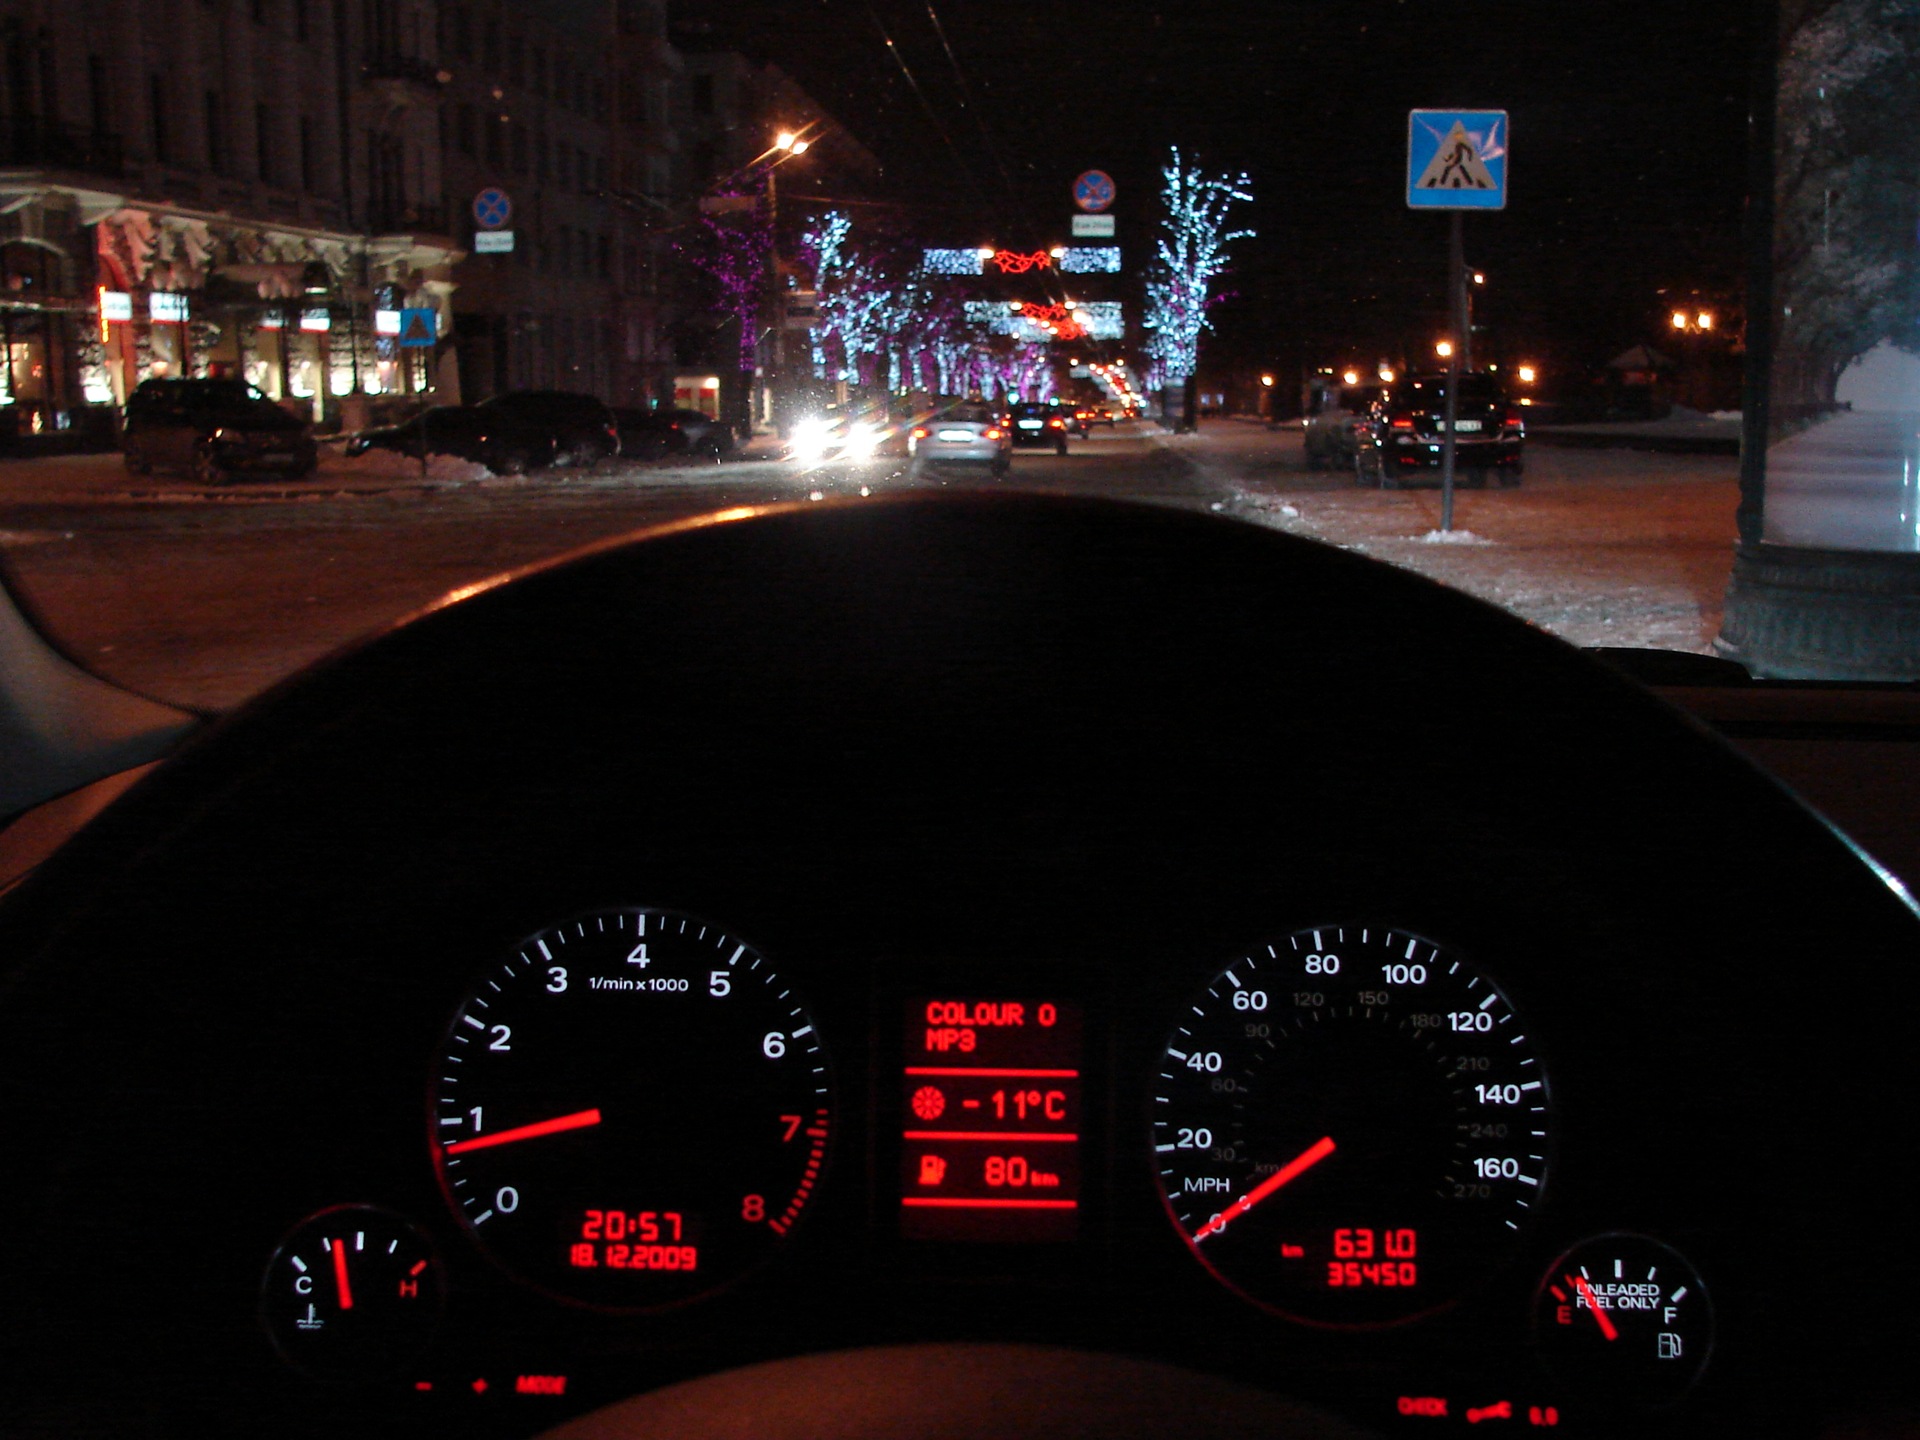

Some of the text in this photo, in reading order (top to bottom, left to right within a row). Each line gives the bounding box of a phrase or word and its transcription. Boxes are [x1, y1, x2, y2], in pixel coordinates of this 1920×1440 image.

[627, 944, 650, 968] 4
[1305, 955, 1340, 975] 80
[546, 966, 568, 993] 3
[709, 971, 731, 997] 5
[1381, 964, 1427, 985] 100
[1232, 990, 1268, 1011] 60
[1292, 992, 1324, 1007] 120
[1358, 991, 1389, 1006] 150
[926, 1002, 1024, 1026] COLOUR
[1411, 1013, 1441, 1029] 180
[1448, 1012, 1493, 1032] 120
[489, 1025, 511, 1051] 2
[926, 1028, 976, 1052] MP3
[1244, 1023, 1270, 1038] 90
[763, 1031, 786, 1059] 6
[1186, 1052, 1222, 1073] 40
[1456, 1056, 1490, 1071] 210
[1474, 1084, 1521, 1104] 140
[469, 1106, 483, 1132] 1
[780, 1115, 802, 1142] 7
[1177, 1128, 1213, 1149] 20
[1469, 1123, 1507, 1138] 240
[1212, 1147, 1237, 1162] 30
[984, 1156, 1028, 1187] 80
[1473, 1158, 1520, 1178] 160
[1184, 1177, 1230, 1193] MPH
[1454, 1183, 1490, 1198] 270
[496, 1186, 519, 1213] 0
[741, 1194, 765, 1222] 8
[582, 1210, 682, 1241] 20:57
[1328, 1262, 1417, 1287] 35450
[295, 1275, 313, 1295] C
[399, 1279, 418, 1297] H
[1576, 1284, 1660, 1297] UNLEADED
[1576, 1296, 1660, 1310] FUEL ONLY
[1556, 1305, 1572, 1325] E
[1664, 1306, 1678, 1324] F
